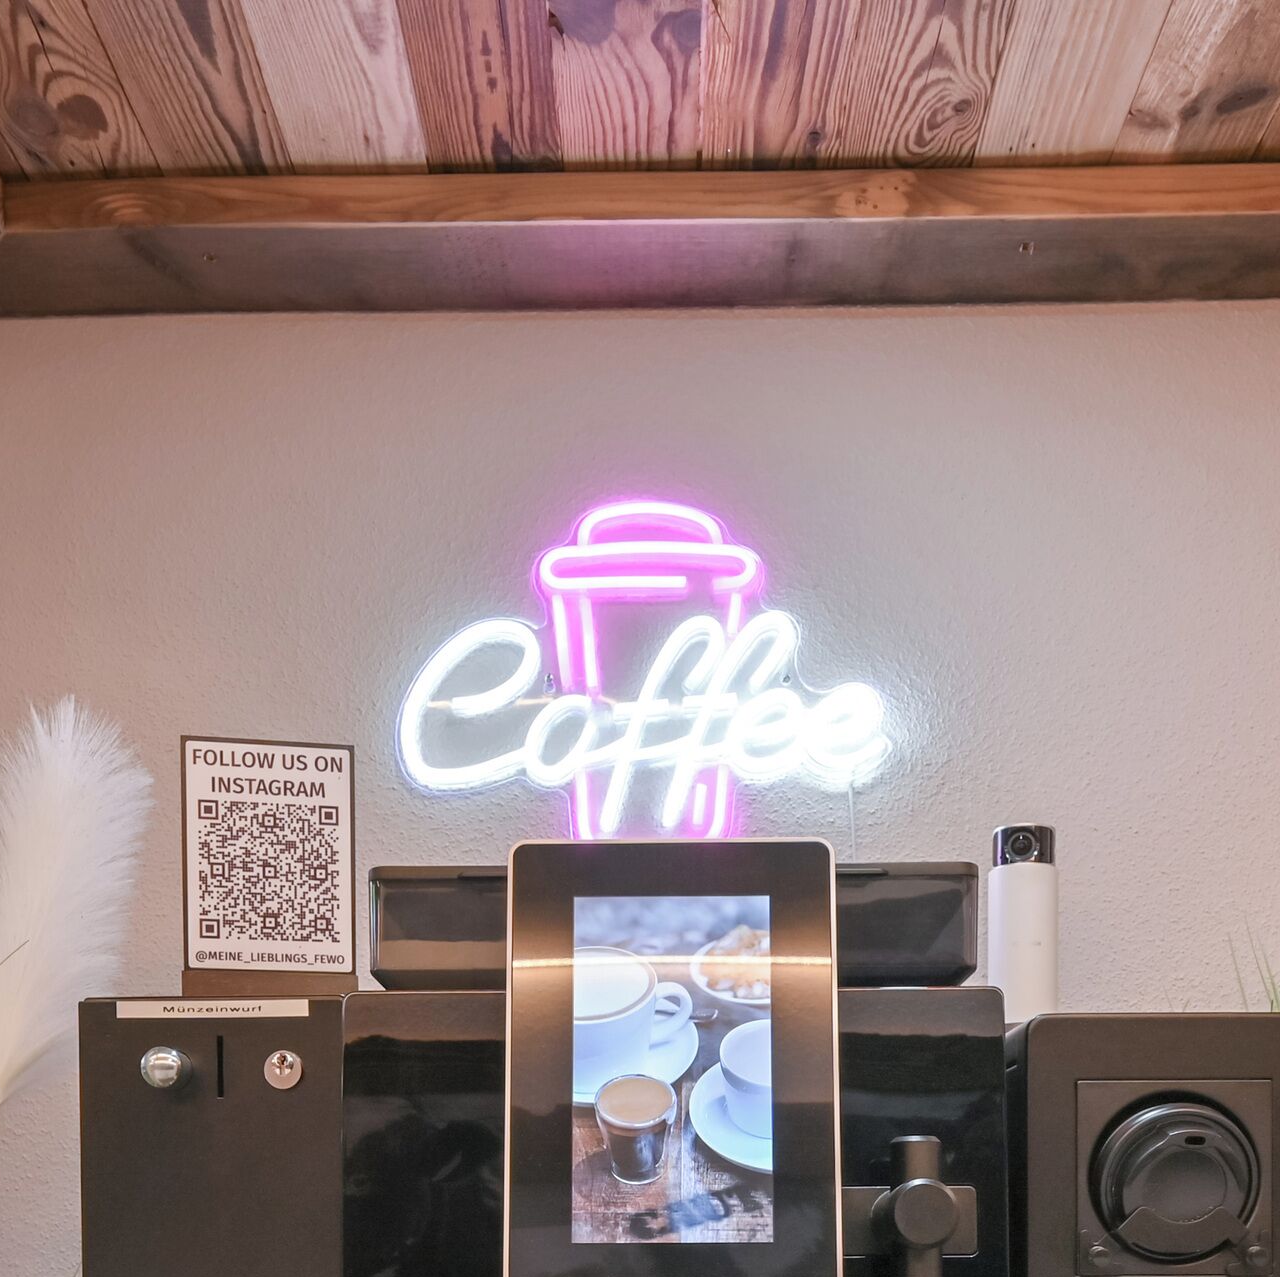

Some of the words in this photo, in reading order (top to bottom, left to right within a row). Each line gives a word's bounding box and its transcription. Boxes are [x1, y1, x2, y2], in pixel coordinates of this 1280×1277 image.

[398, 609, 892, 834] Coffee
[192, 749, 276, 769] FOLLOW
[282, 753, 308, 771] US
[314, 756, 343, 773] ON
[211, 776, 326, 798] INSTAGRAM
[195, 950, 345, 965] @MEINE_LIEBLINGS_FEWO
[163, 1004, 262, 1014] Münzeinwurf
